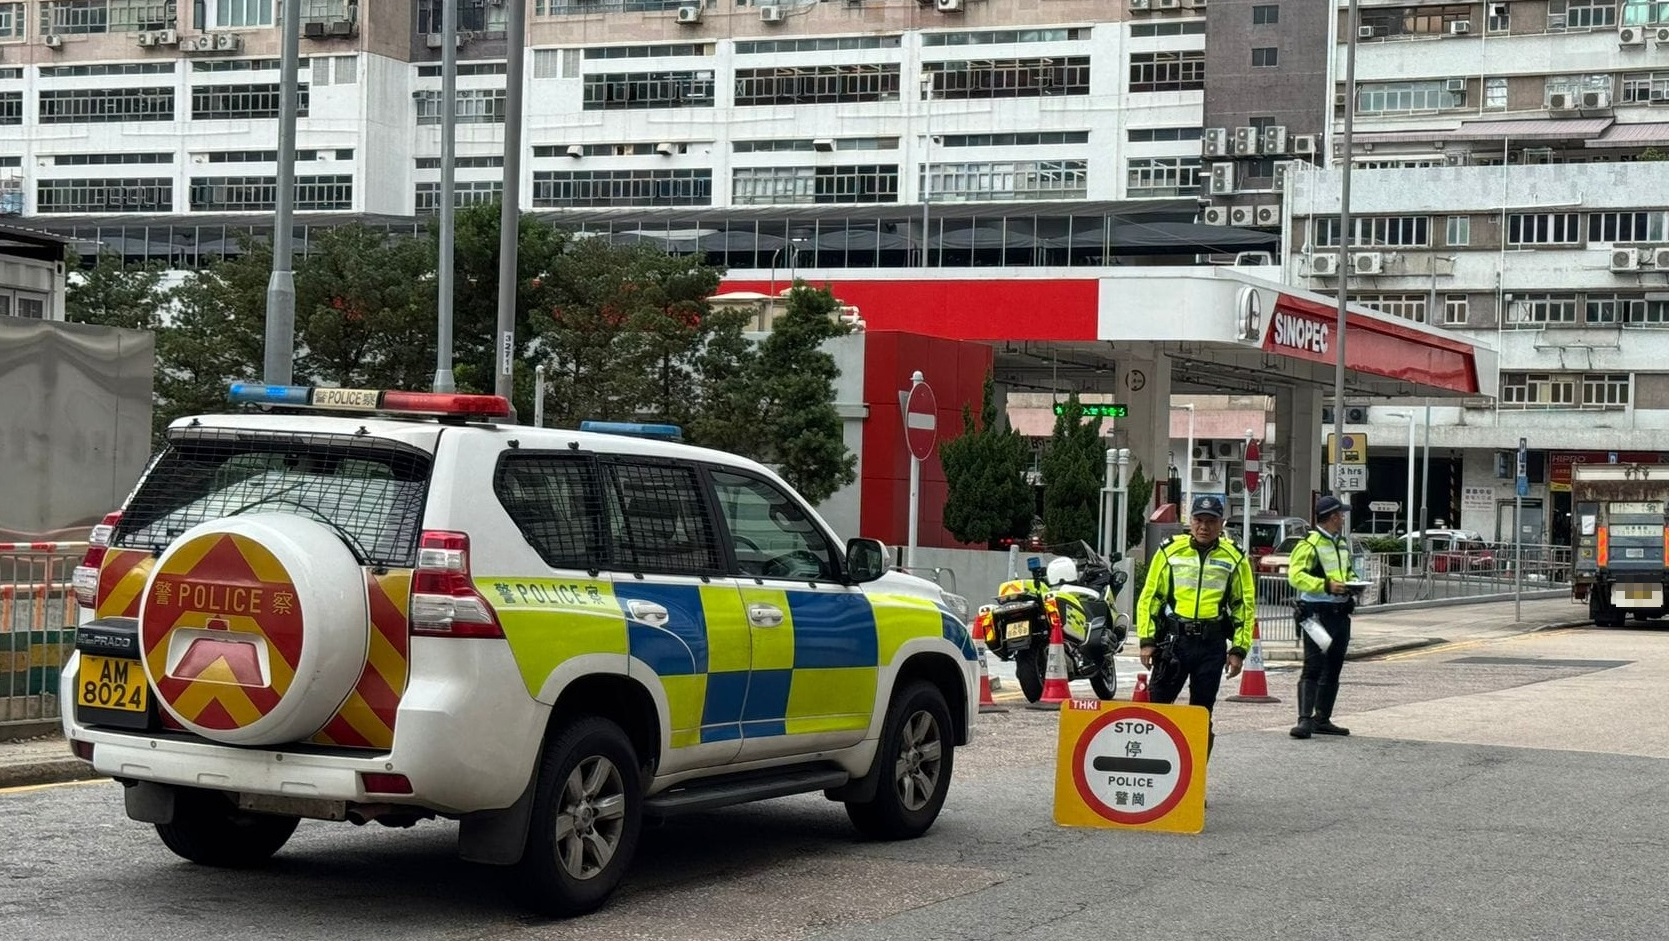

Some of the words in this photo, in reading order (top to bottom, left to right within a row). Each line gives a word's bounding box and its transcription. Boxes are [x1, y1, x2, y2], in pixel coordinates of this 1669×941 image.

[1274, 312, 1328, 353] SINOPEC
[315, 390, 325, 403] 警
[327, 390, 361, 405] POLICE
[363, 392, 375, 405] 察
[1552, 455, 1586, 463] HIPRO
[1347, 467, 1362, 475] hrs
[155, 581, 172, 605] 警
[178, 583, 263, 613] POLICE
[272, 591, 293, 615] 察
[494, 582, 516, 604] 警
[516, 583, 587, 604] POLICE
[585, 584, 605, 605] 察
[94, 635, 131, 647] PRADO
[99, 659, 129, 684] AM
[83, 681, 142, 709] 8024
[1073, 700, 1097, 710] THKI
[1114, 722, 1155, 735] STOP
[1125, 740, 1142, 757] 停
[1108, 776, 1154, 788] POLICE
[1115, 791, 1145, 806] 警崗
